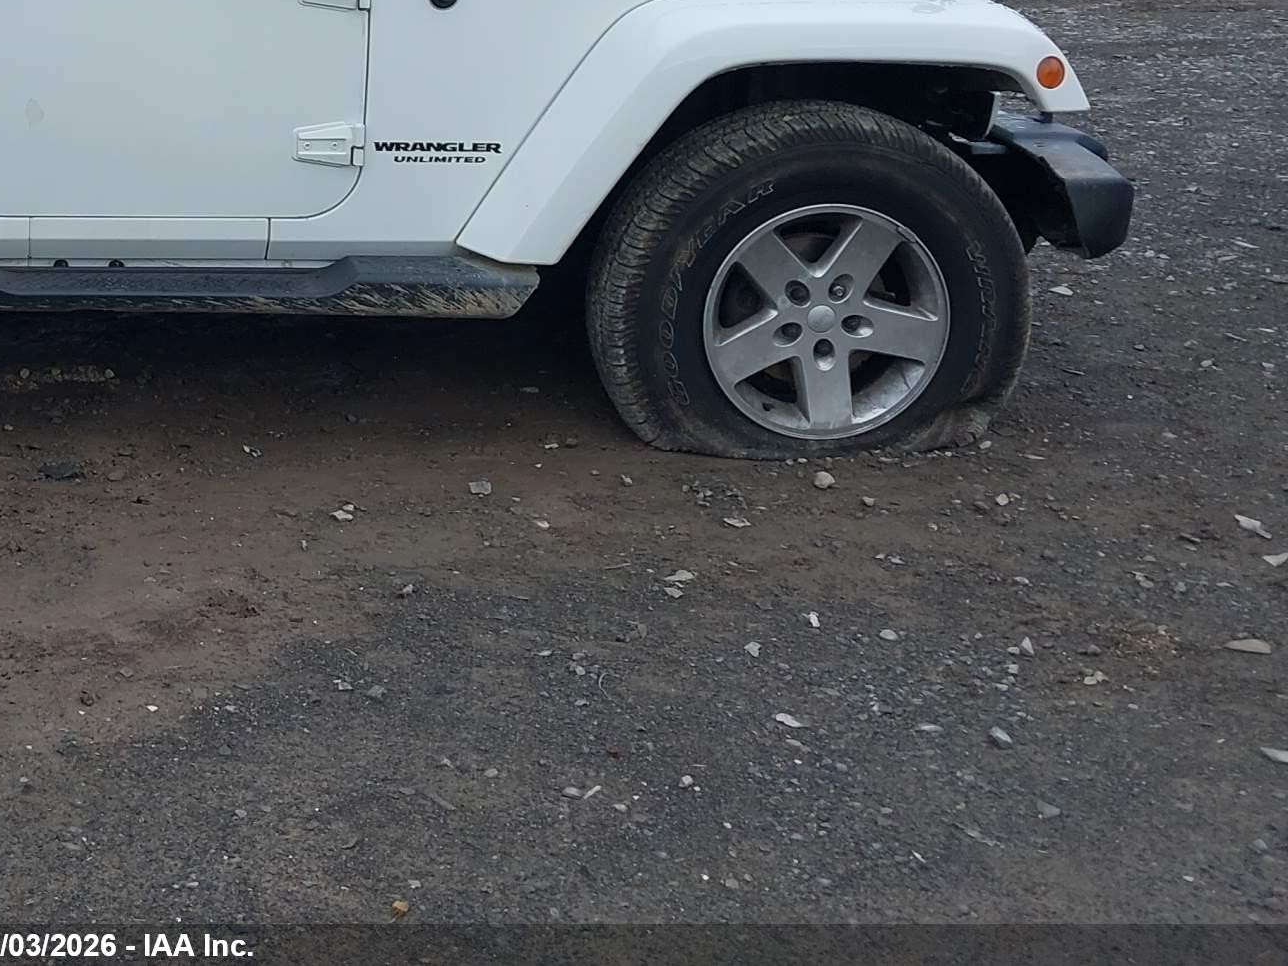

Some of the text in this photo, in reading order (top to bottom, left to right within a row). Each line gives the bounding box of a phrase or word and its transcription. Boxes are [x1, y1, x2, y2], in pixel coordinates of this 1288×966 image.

[373, 141, 502, 154] WRANGLER
[393, 155, 486, 164] UNLIMITED
[659, 177, 775, 406] GOODYEAR
